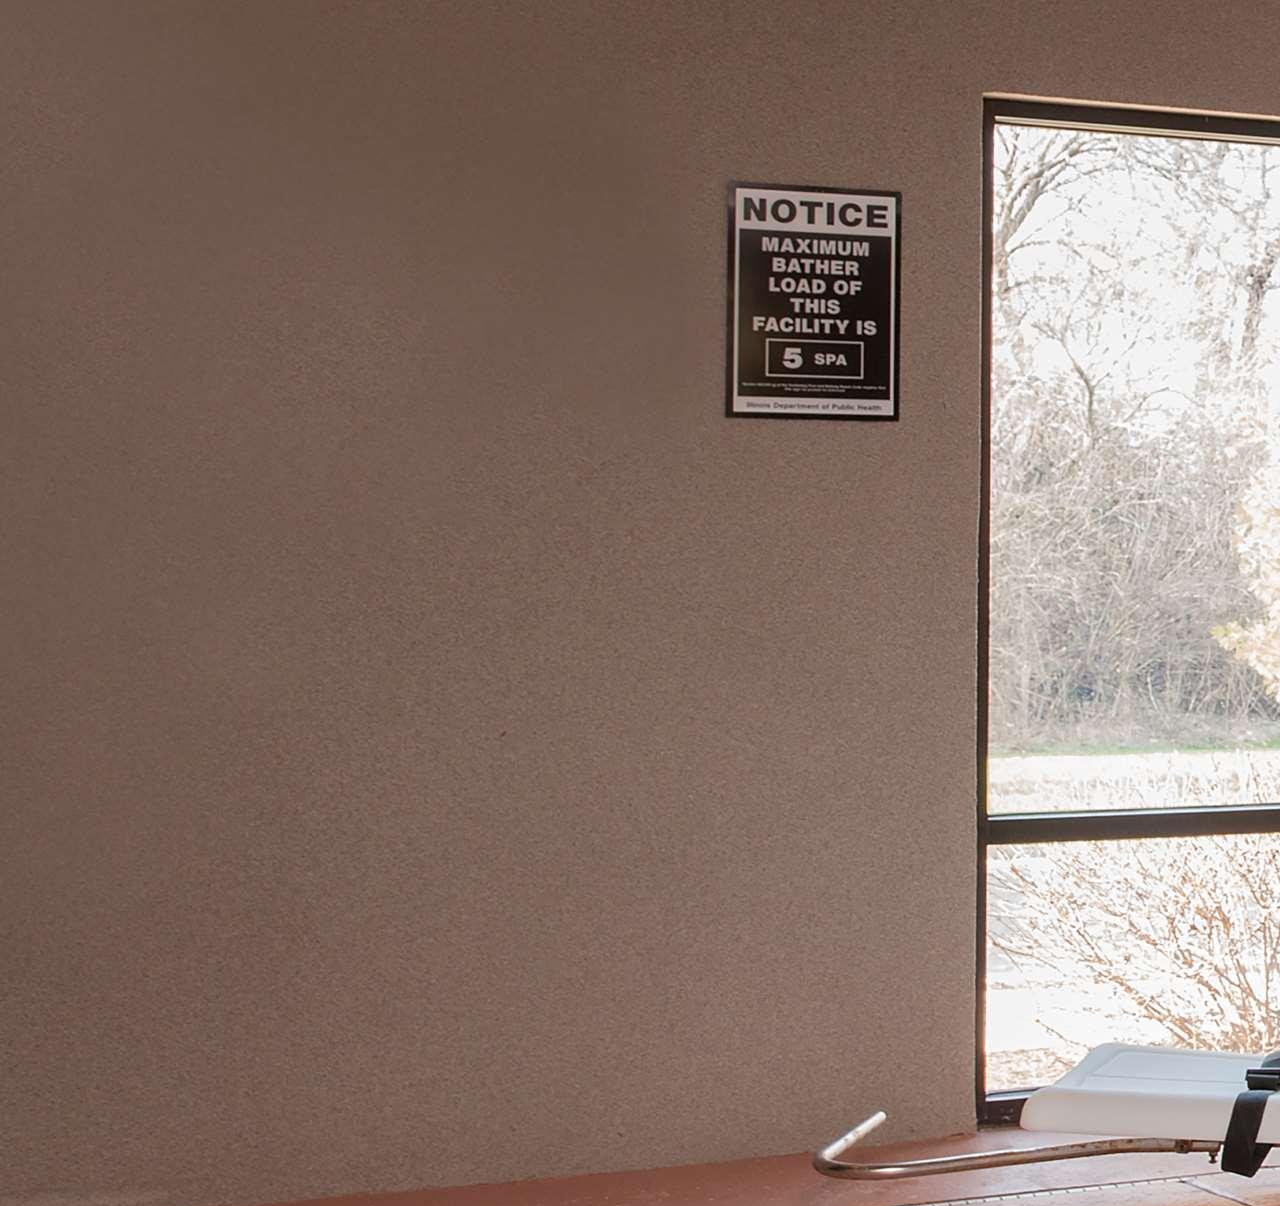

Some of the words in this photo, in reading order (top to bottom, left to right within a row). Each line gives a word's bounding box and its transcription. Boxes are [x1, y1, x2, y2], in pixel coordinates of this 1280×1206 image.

[742, 196, 889, 229] NOTICE
[761, 236, 870, 257] MAXIMUM
[771, 257, 860, 276] BATHER
[768, 277, 827, 295] LOAD
[833, 279, 863, 296] OF
[789, 297, 841, 314] THIS
[752, 316, 850, 335] FACILITY
[856, 320, 878, 336] IS
[782, 346, 804, 369] 5
[814, 351, 848, 367] SPA
[773, 402, 819, 412] Department
[821, 403, 830, 411] of
[831, 403, 855, 412] Public
[857, 404, 882, 413] Health
